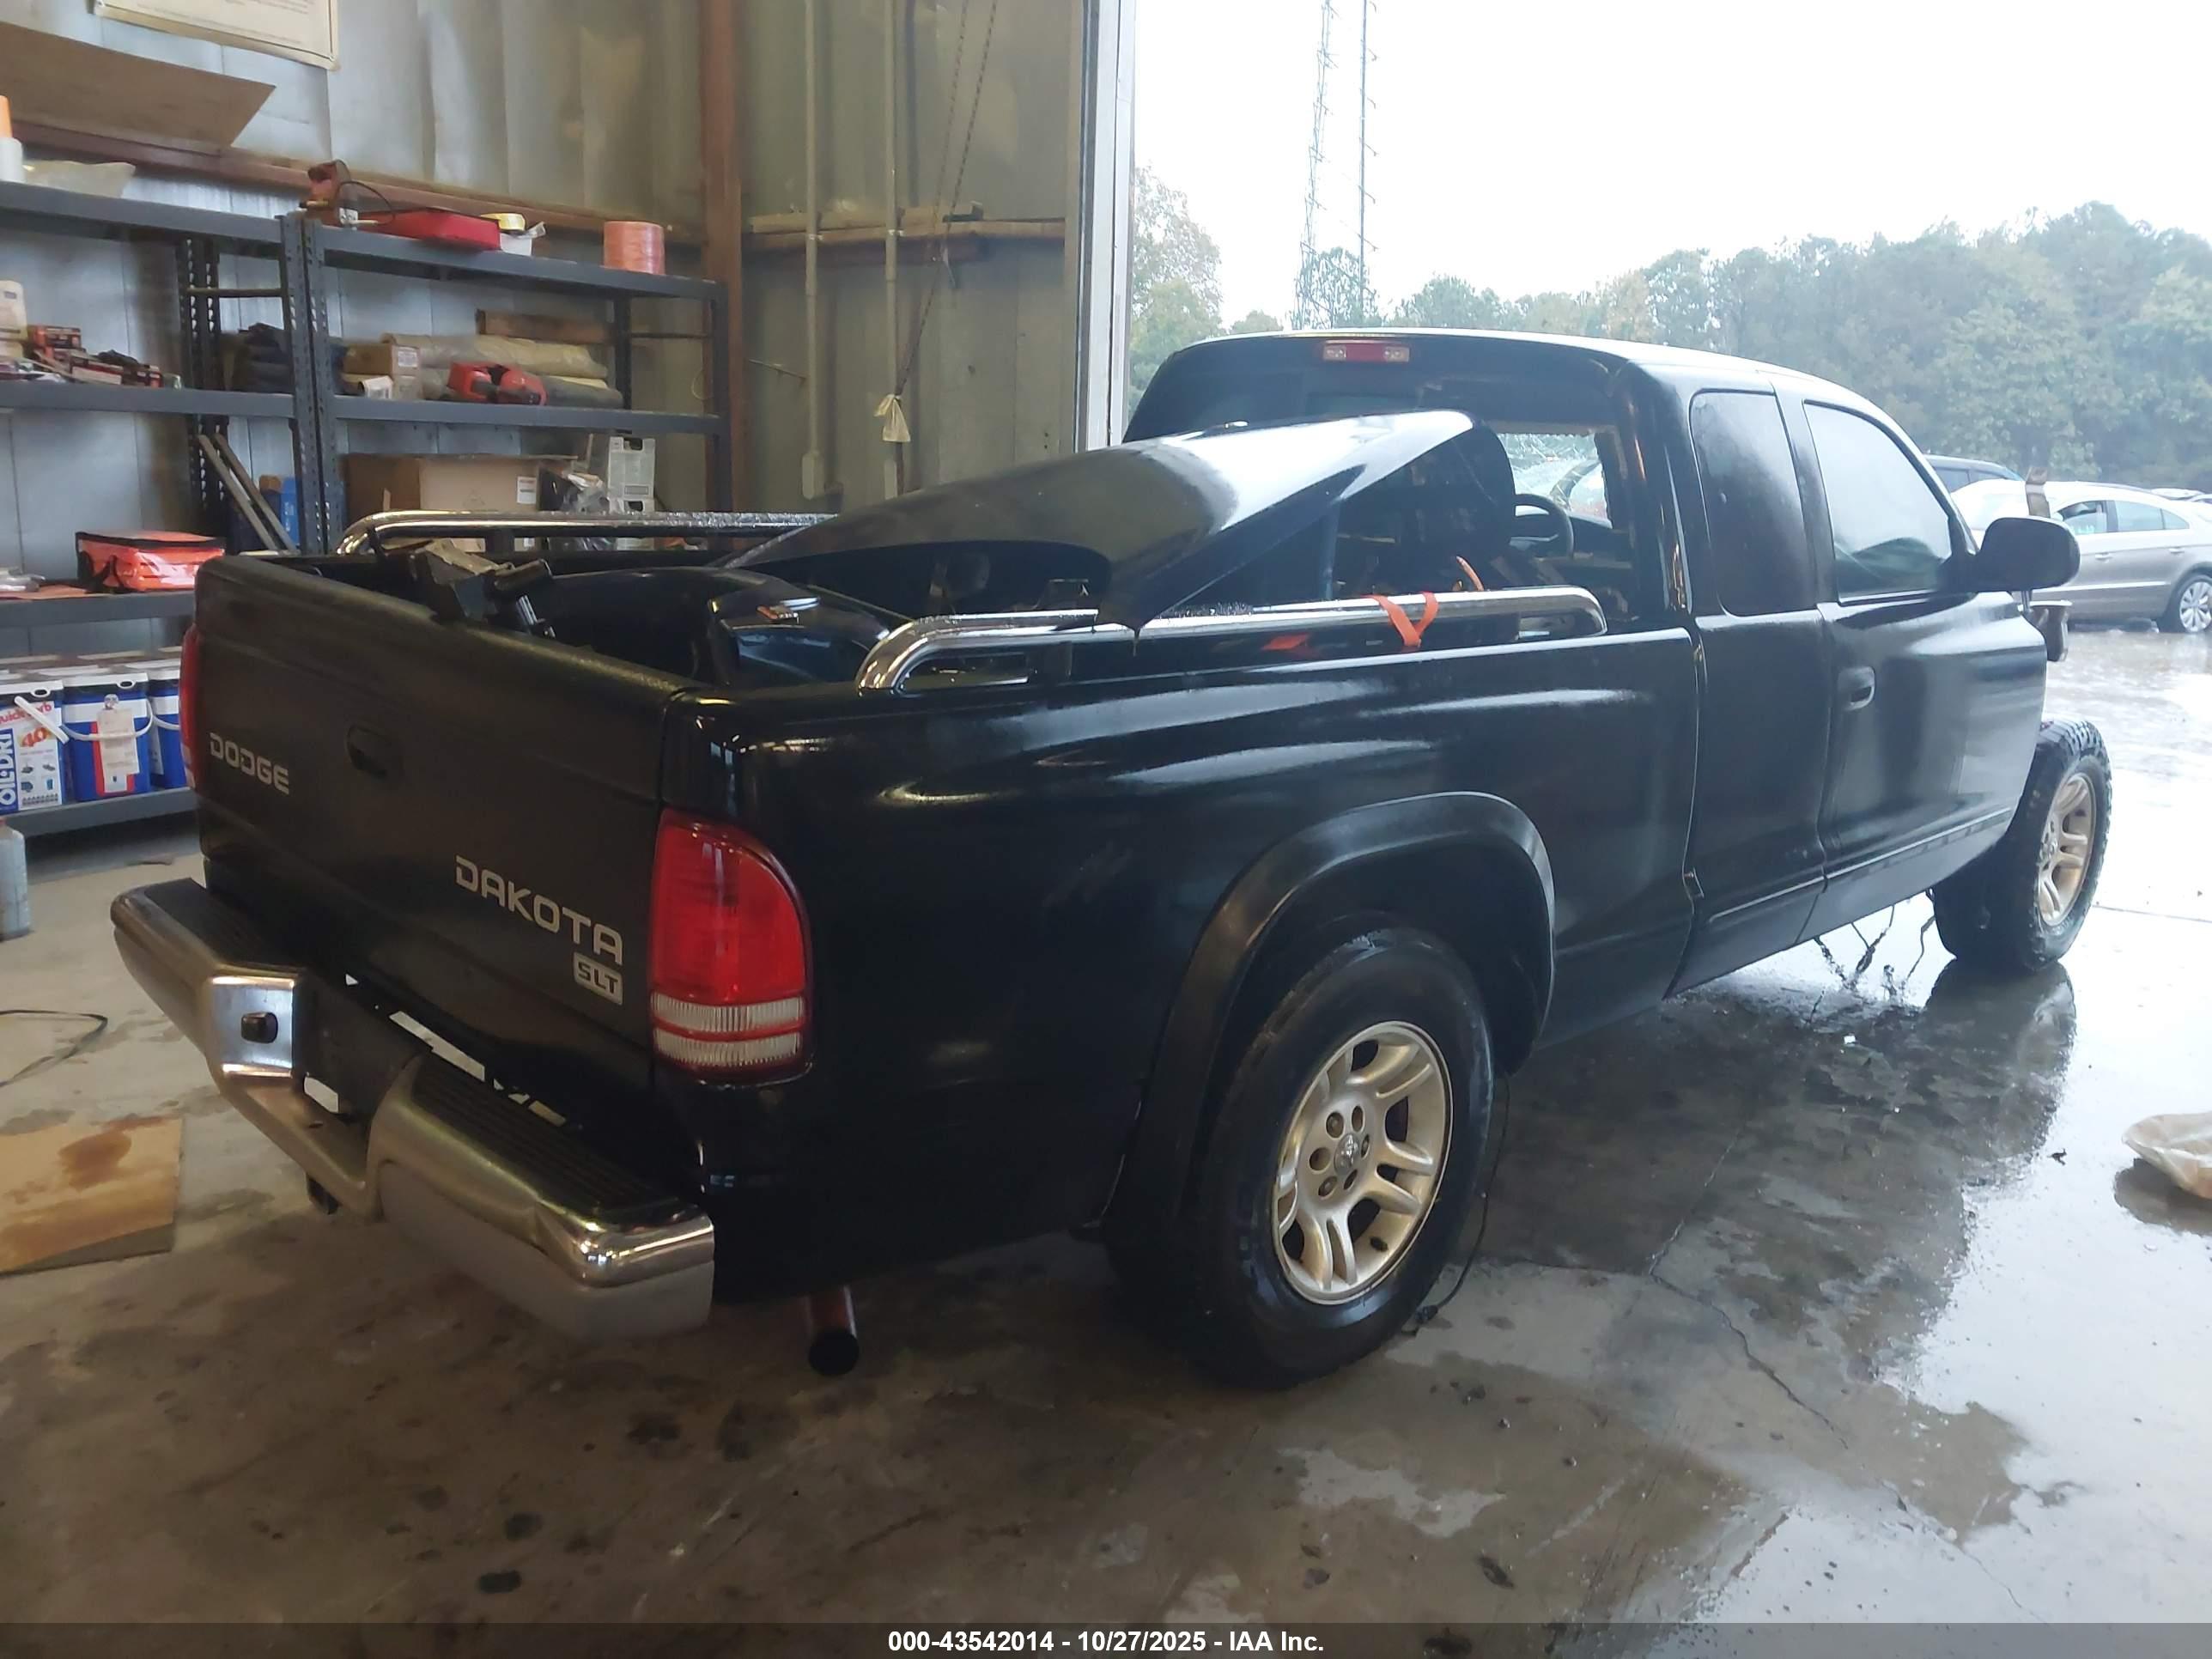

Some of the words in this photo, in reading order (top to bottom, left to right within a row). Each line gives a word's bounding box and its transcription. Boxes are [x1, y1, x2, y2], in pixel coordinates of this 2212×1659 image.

[210, 732, 289, 795] DODGE
[456, 855, 623, 966] DAKOTA
[578, 961, 618, 994] SLT
